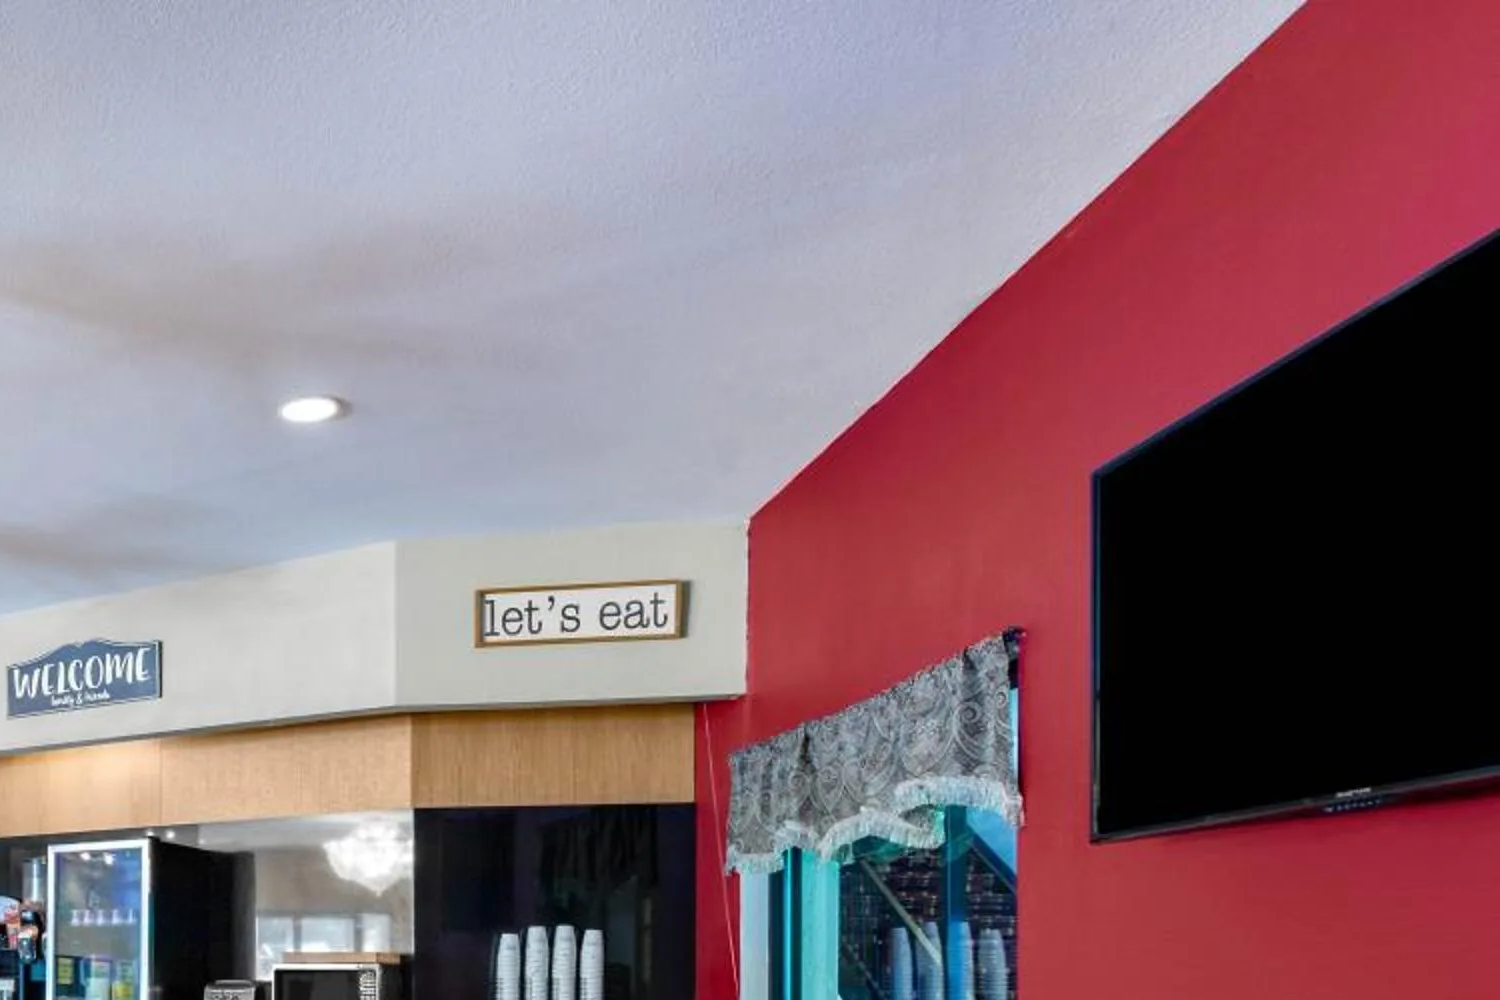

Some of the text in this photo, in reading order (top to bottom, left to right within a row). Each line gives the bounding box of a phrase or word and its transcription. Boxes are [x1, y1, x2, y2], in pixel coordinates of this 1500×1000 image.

[484, 592, 668, 637] let's eat
[13, 647, 152, 699] WELCOME
